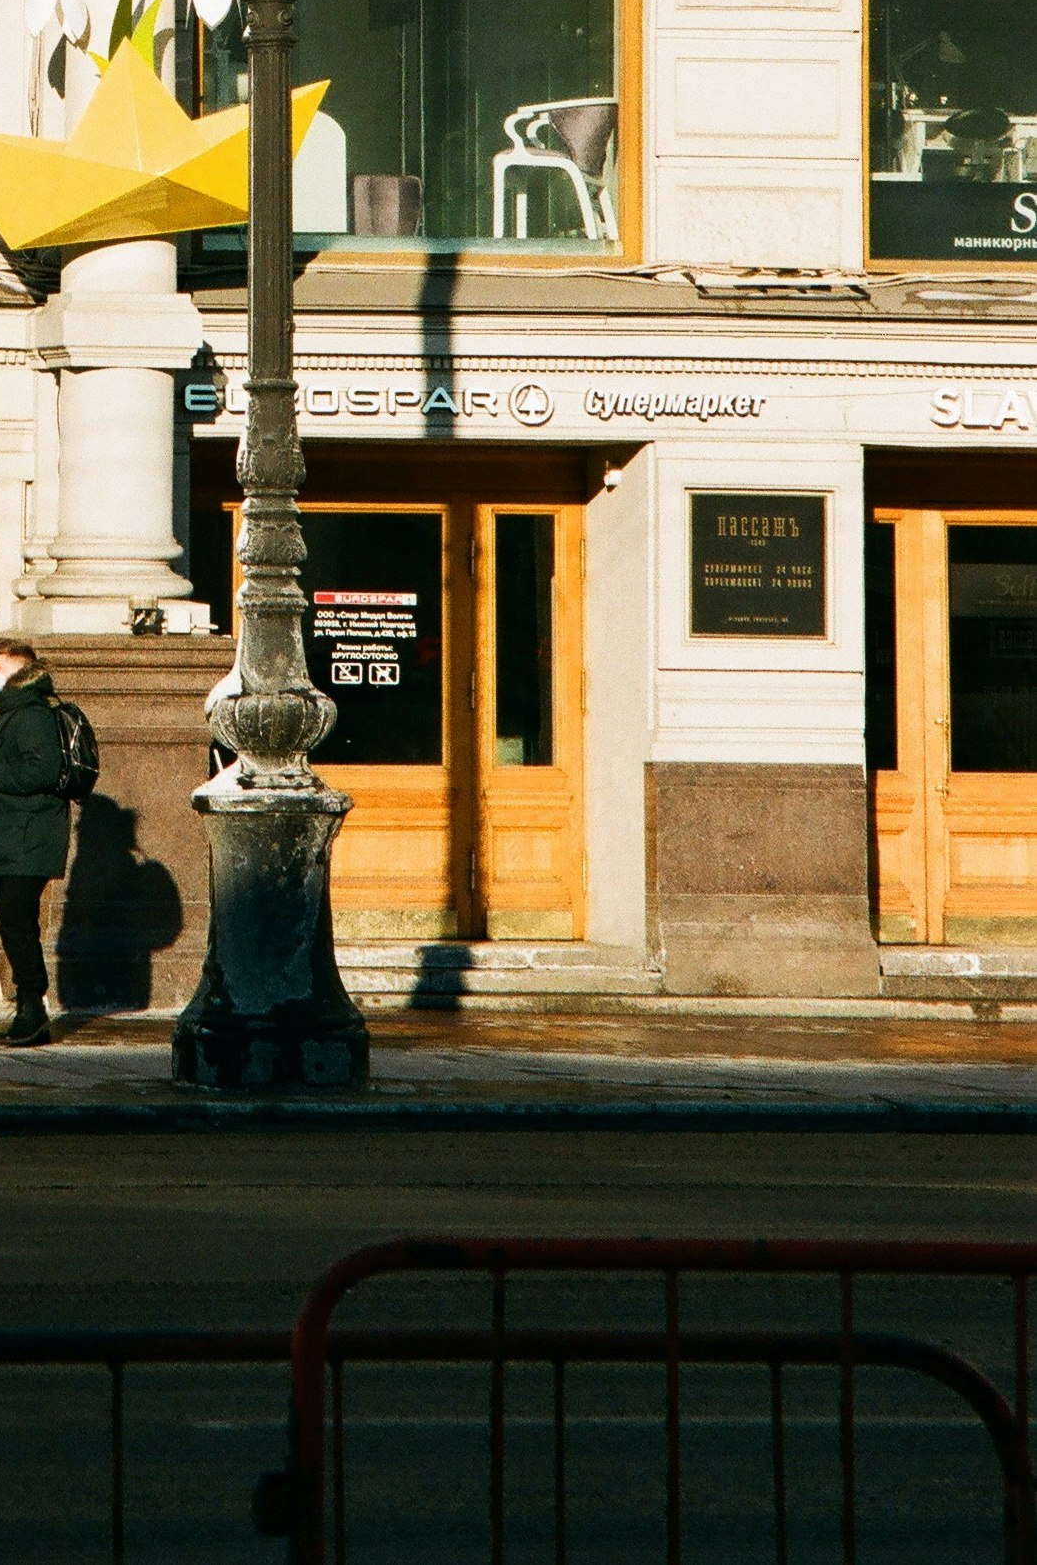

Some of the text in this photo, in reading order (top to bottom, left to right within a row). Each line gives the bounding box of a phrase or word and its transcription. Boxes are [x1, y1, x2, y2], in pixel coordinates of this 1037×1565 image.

[184, 383, 499, 416] EUOSPAR
[584, 387, 766, 422] Супермаркет
[334, 594, 401, 603] EUROSPAR
[316, 610, 334, 618] ООО
[331, 651, 398, 660] КРУГЛОСУТОЧНО
